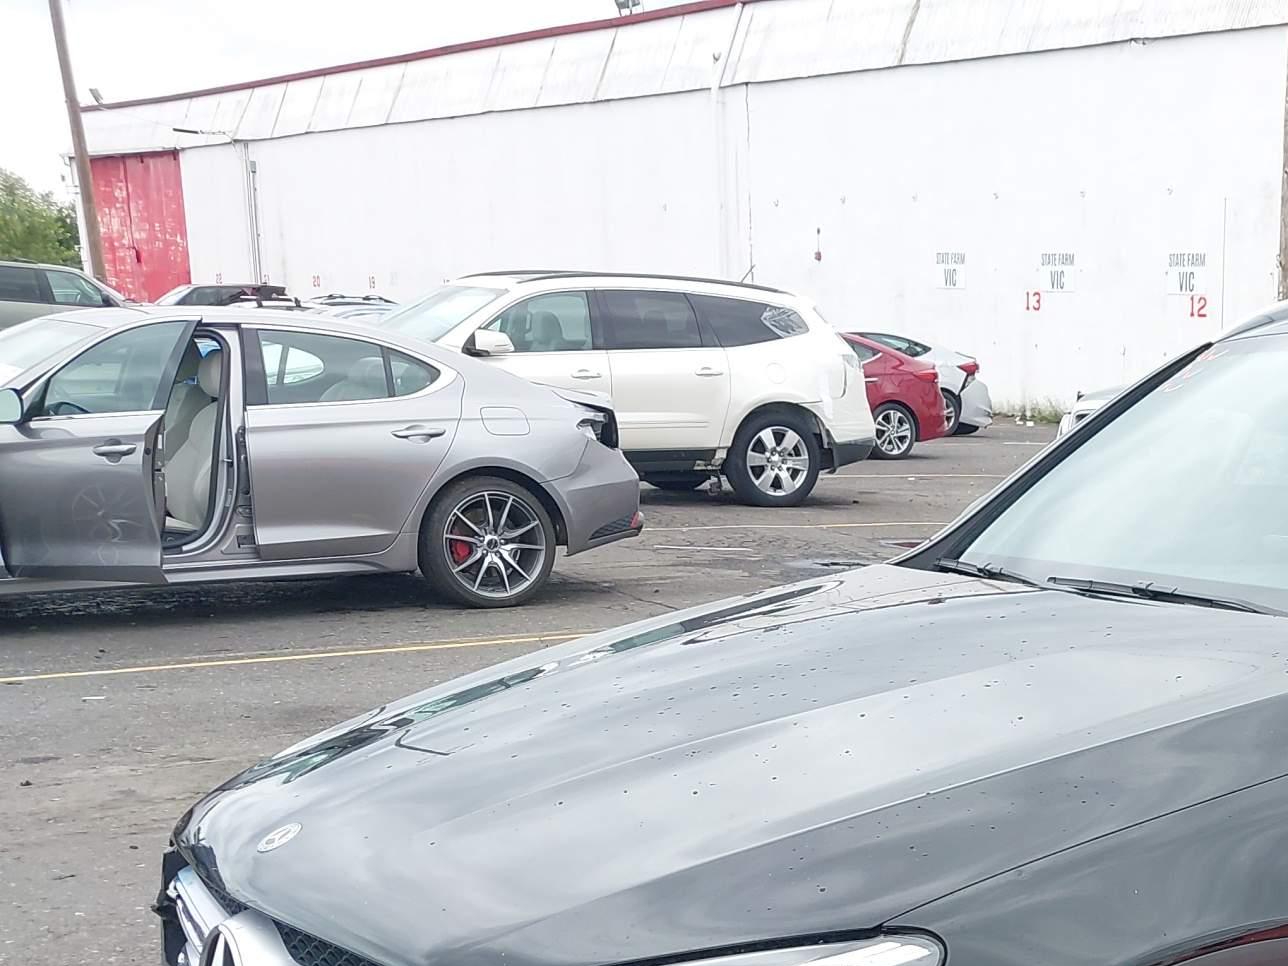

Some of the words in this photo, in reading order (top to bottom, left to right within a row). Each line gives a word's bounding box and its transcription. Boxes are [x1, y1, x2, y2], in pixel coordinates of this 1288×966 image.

[936, 252, 949, 265] STATE
[1041, 253, 1057, 266] STATE
[1058, 253, 1075, 266] FARM
[1168, 253, 1186, 267] STATE
[1187, 253, 1206, 267] FARM
[944, 268, 957, 287] VIC
[1050, 270, 1065, 290] VIC
[1178, 271, 1195, 292] VIC
[1025, 290, 1041, 311] 13
[1190, 295, 1207, 317] 12
